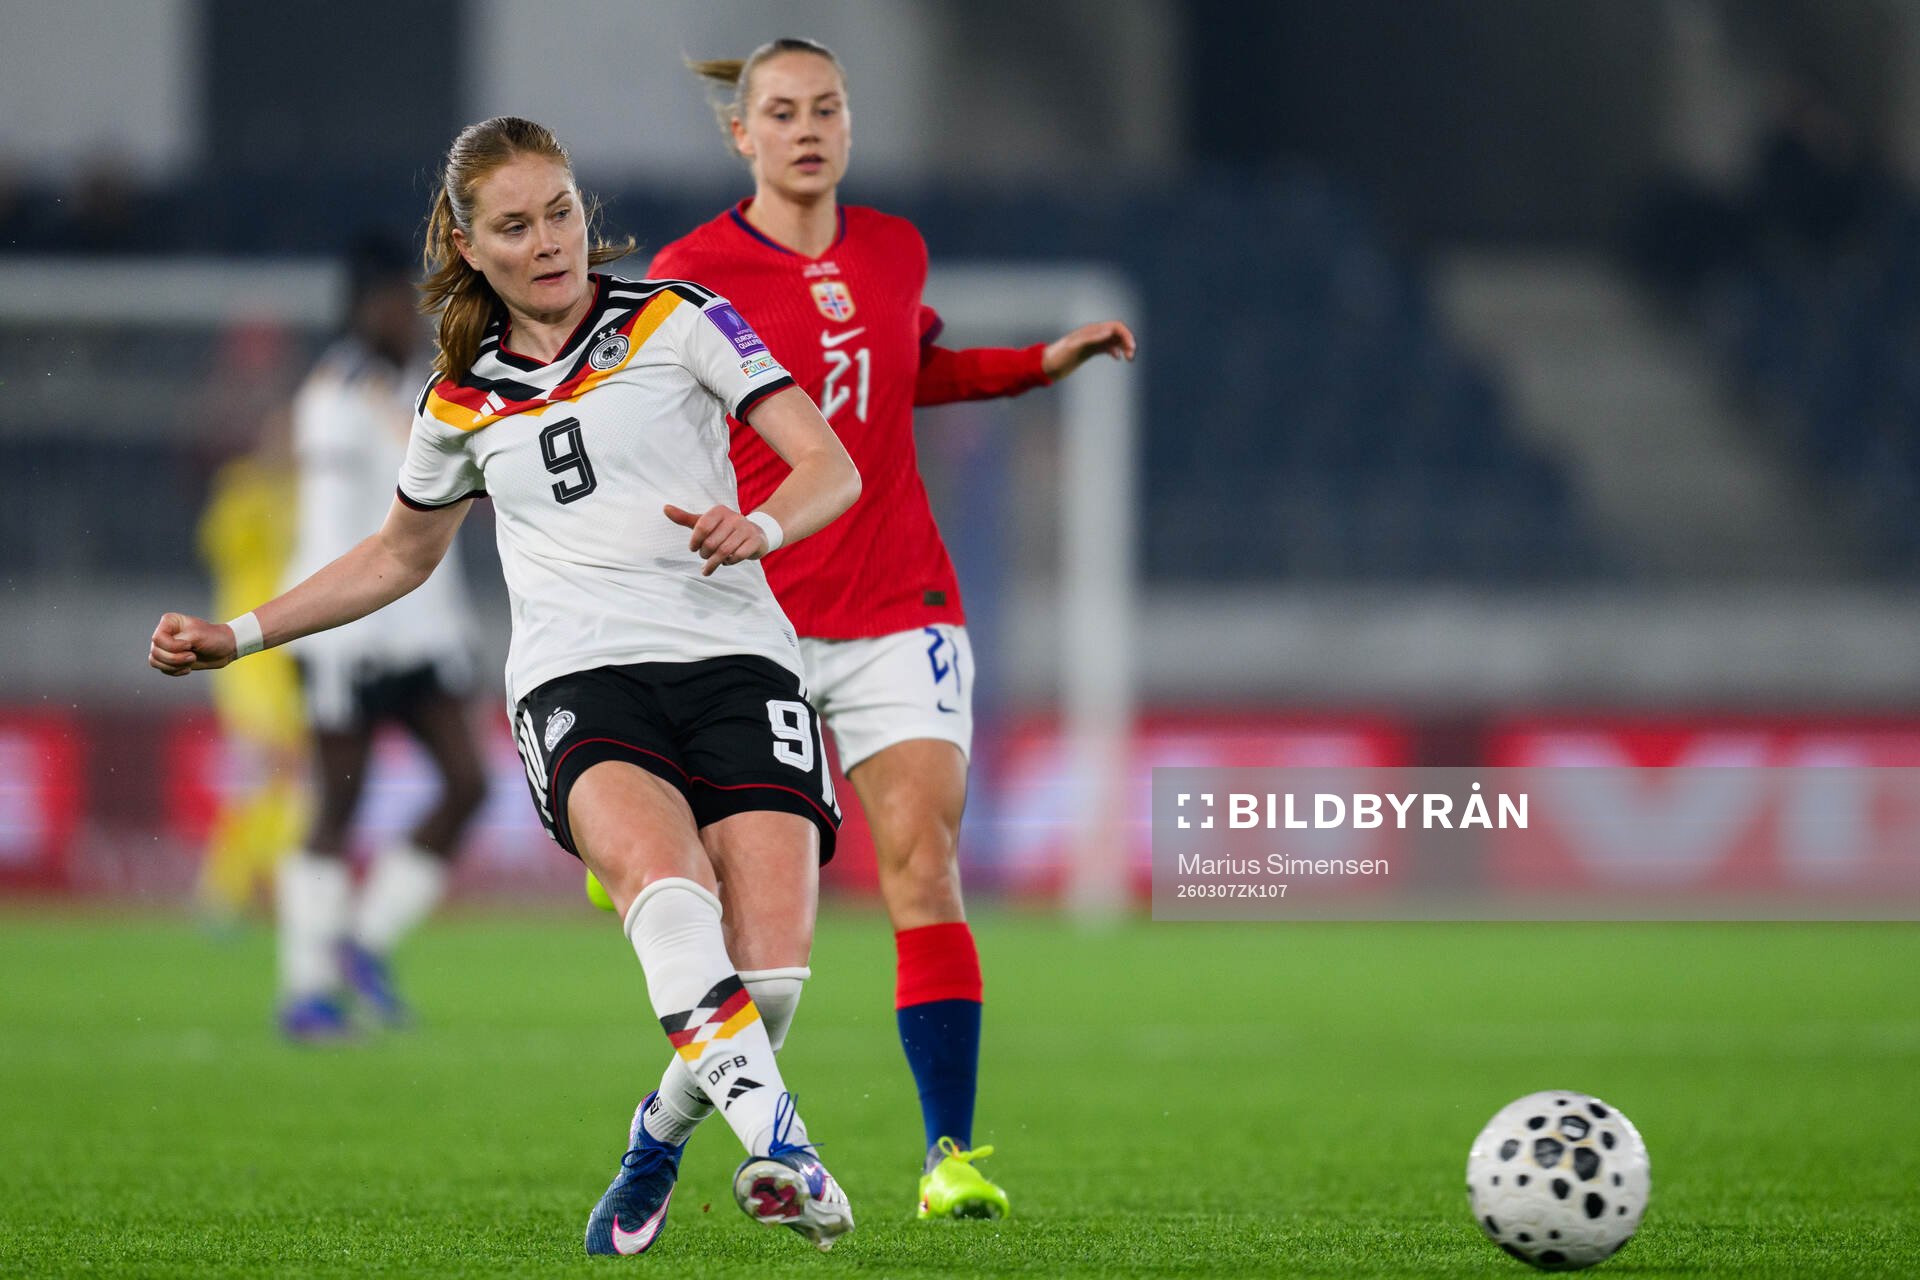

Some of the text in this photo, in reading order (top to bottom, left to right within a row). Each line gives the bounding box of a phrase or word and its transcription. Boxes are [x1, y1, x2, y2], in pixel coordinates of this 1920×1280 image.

[821, 348, 870, 423] 21
[538, 416, 598, 505] 9
[766, 699, 814, 773] 9
[707, 1055, 748, 1086] DFB
